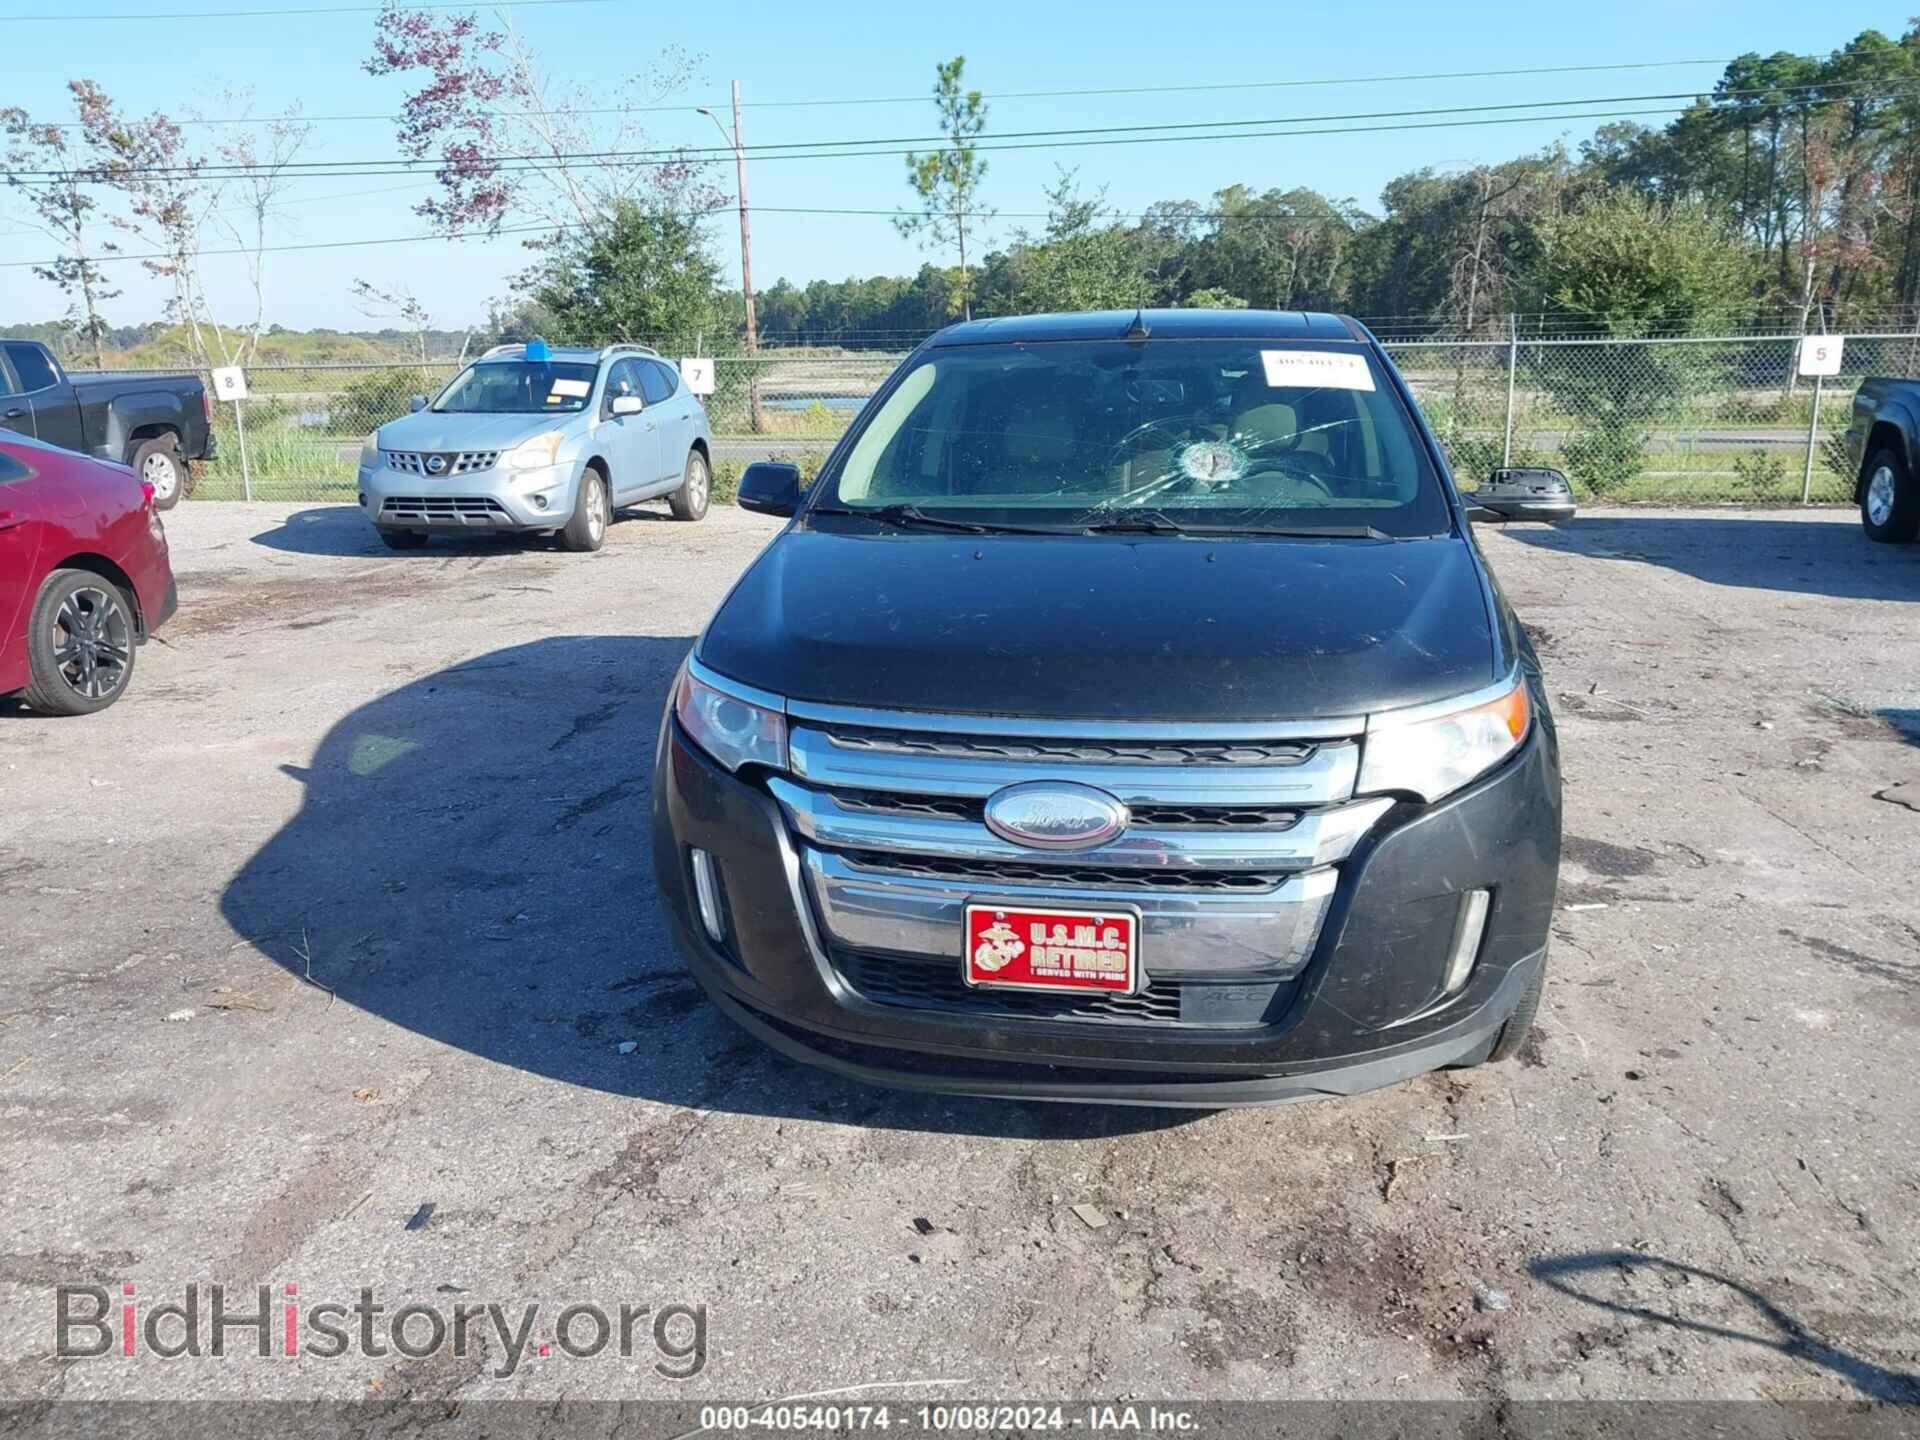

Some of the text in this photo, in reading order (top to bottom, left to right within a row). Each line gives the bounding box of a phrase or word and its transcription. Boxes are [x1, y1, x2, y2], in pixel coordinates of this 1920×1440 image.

[1816, 347, 1826, 361] 5
[692, 368, 702, 381] 7
[224, 376, 234, 389] 8
[1030, 923, 1127, 948] U.S.M.C.
[1030, 946, 1126, 971] RETIRED
[1036, 968, 1071, 977] SERVED
[1073, 970, 1096, 979] WITH
[1099, 972, 1126, 981] PRIDE
